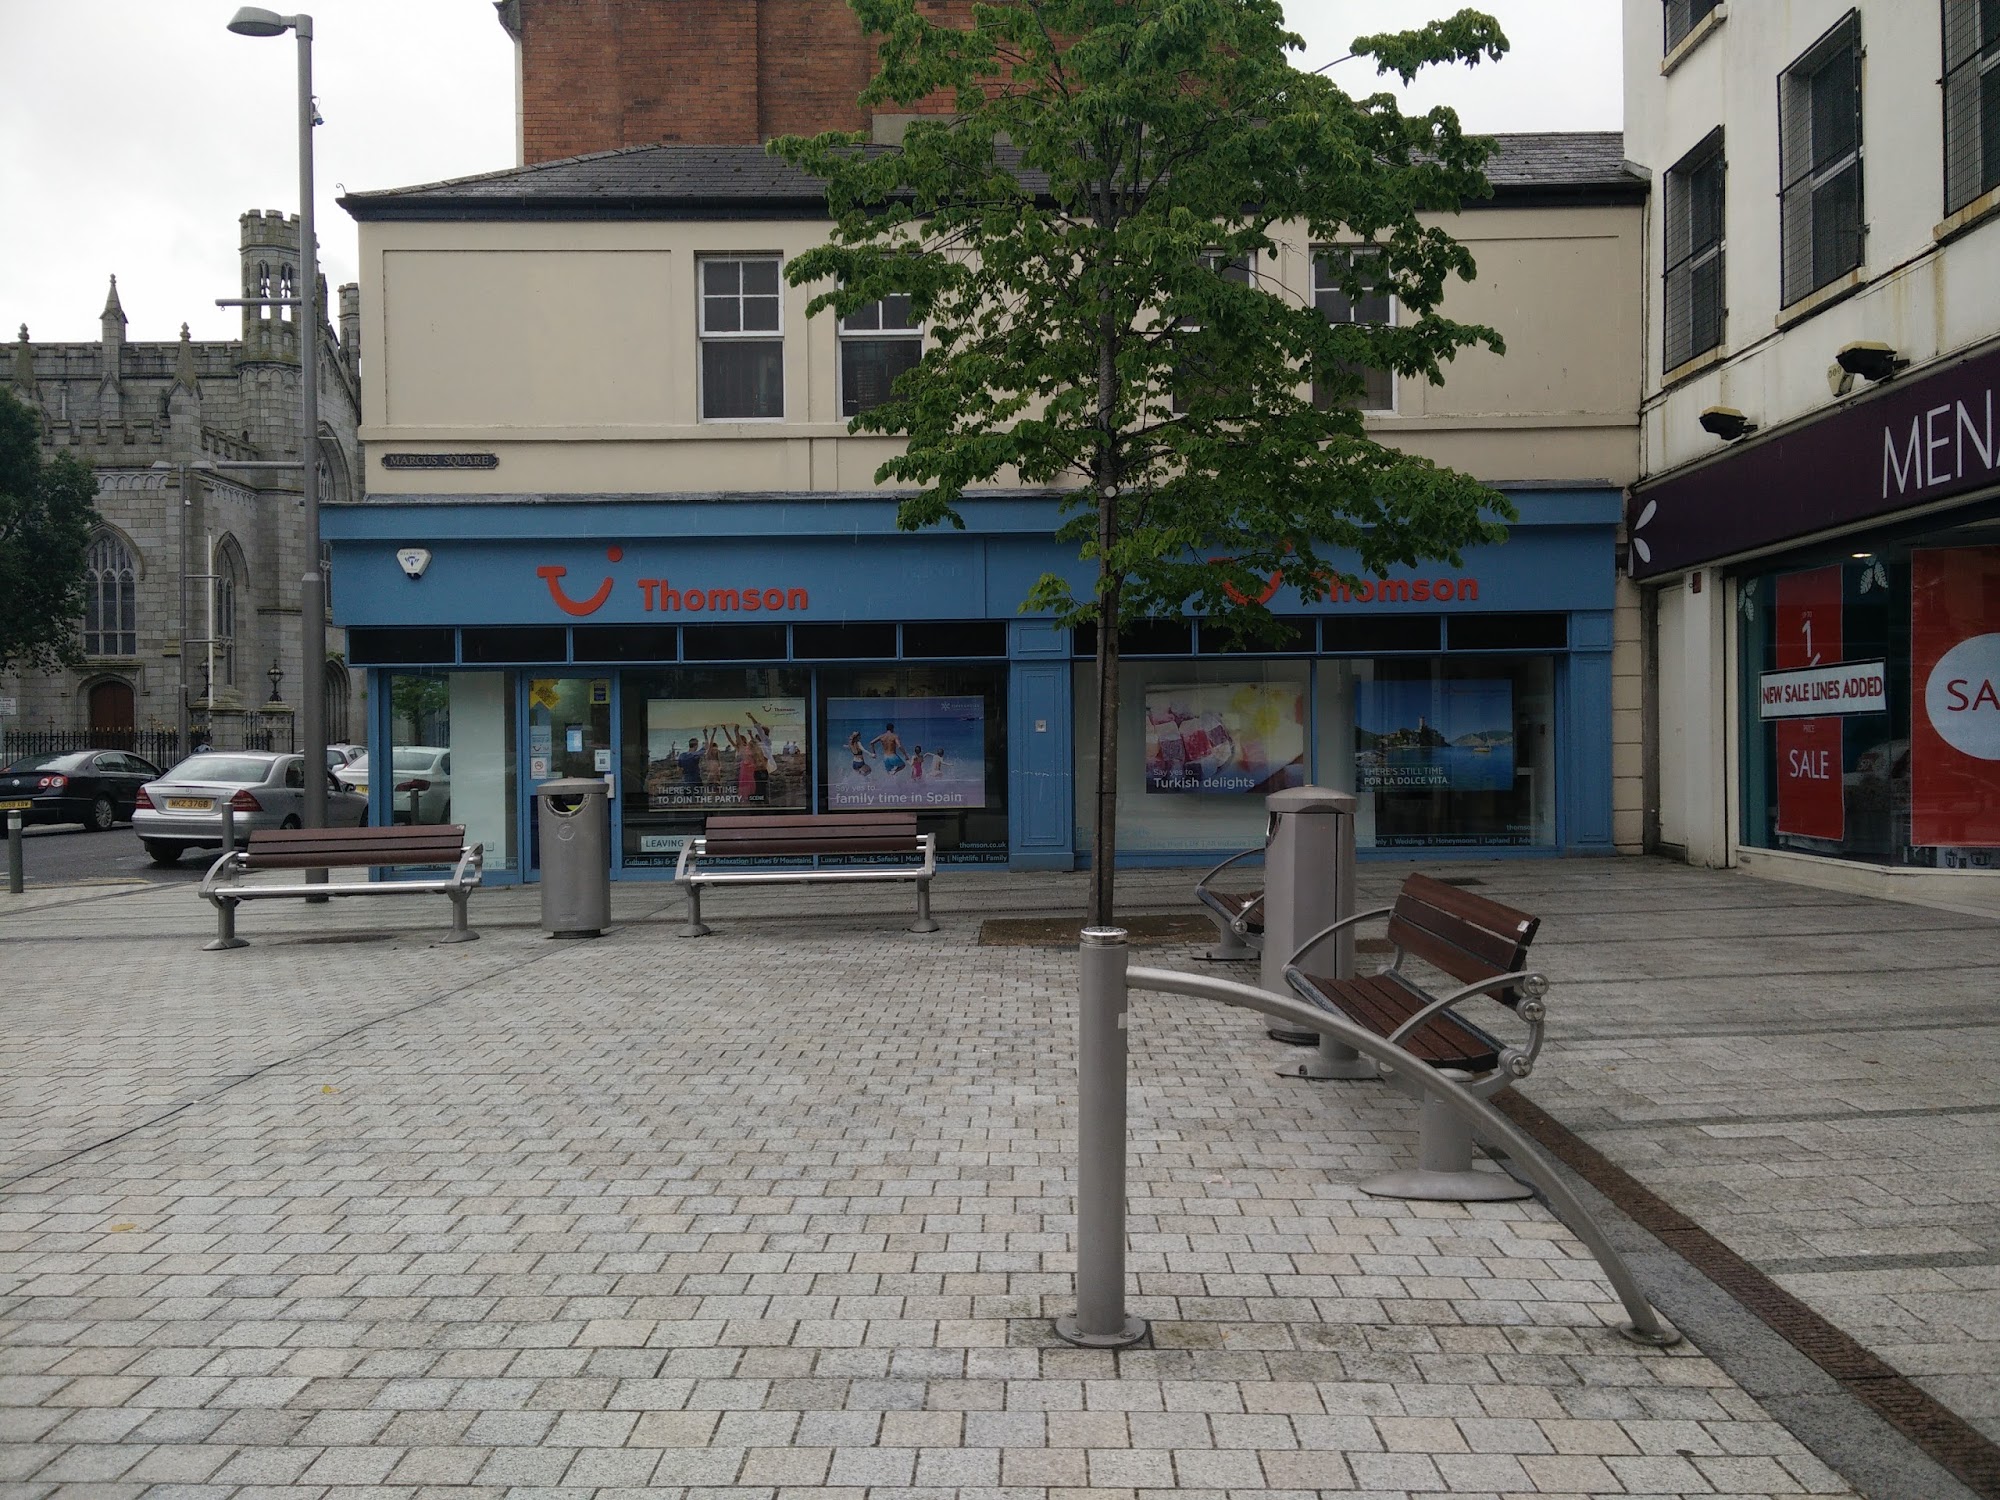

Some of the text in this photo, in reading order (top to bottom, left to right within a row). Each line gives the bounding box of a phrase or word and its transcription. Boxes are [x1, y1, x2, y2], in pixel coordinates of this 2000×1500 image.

[1883, 389, 2000, 499] MEN
[390, 456, 490, 468] MARCUS SQUARE
[637, 579, 808, 612] Thomson
[1762, 676, 1883, 704] NEW SALE LINES ADDED
[1789, 748, 1830, 780] SALE
[1153, 769, 1168, 777] Say
[1363, 766, 1444, 776] THERE'S STILL TIME
[1153, 777, 1255, 790] Turkish delights
[1364, 777, 1381, 786] FOR
[1384, 777, 1395, 785] LA
[1397, 776, 1426, 785] DOLCE
[656, 785, 737, 795] THERE'S STILL TIME
[657, 796, 670, 804] TO
[672, 796, 692, 804] JOIN
[695, 795, 713, 803] THE
[836, 791, 963, 805] family time in Spain
[645, 839, 684, 848] LEAVING
[959, 841, 1007, 850] thomson.co.uk
[1394, 838, 1425, 846] Weddings
[1436, 837, 1477, 846] Honeymoons
[1484, 836, 1511, 845] Lapland
[653, 858, 664, 866] Ski
[715, 857, 749, 865] Relaxation
[780, 856, 812, 864] Mountains
[820, 856, 843, 864] Luxury
[877, 855, 899, 863] Safaris
[952, 855, 979, 863] Nightlife
[986, 855, 1008, 863] Family
